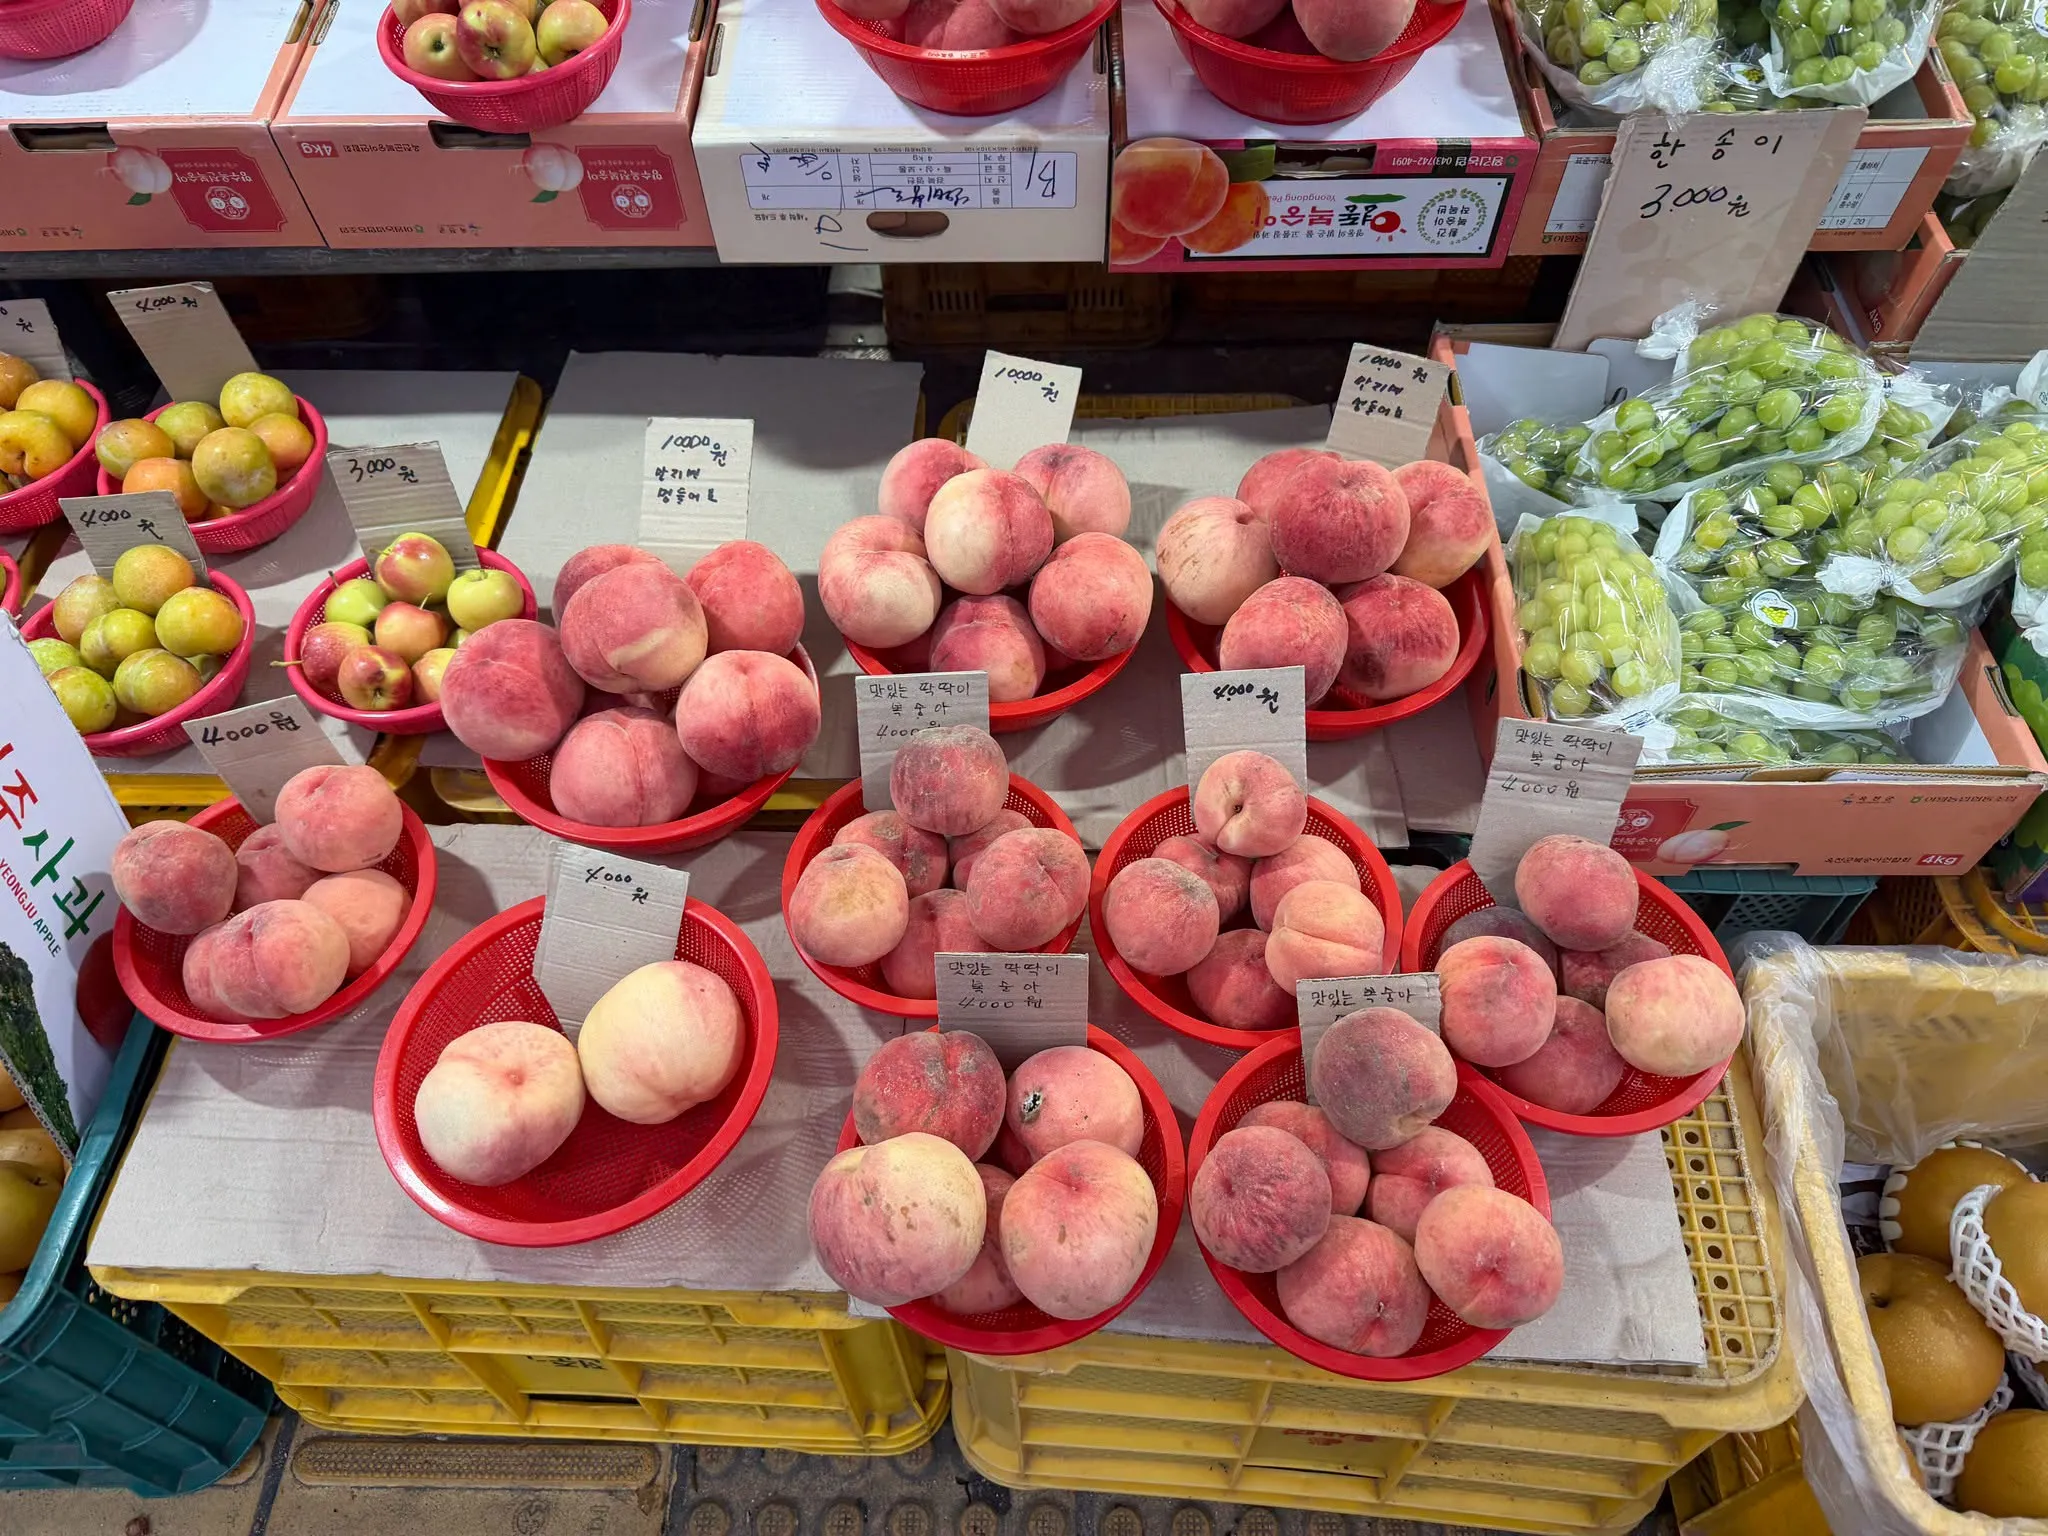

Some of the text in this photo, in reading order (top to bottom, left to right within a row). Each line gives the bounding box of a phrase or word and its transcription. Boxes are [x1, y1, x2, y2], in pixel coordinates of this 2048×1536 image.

[301, 142, 333, 157] 4kg
[1391, 155, 1504, 167] 황간농협 043)742-4091
[1285, 193, 1336, 203] Yeongdong
[1434, 216, 1468, 227] 복숭아
[1437, 227, 1459, 238] 황간
[868, 682, 909, 699] 맛있는
[1514, 727, 1554, 748] 맛있는
[1920, 854, 1958, 866] 4kg
[0, 857, 62, 959] YEONGJU APPLE
[948, 961, 994, 977] 맛있는
[1311, 988, 1356, 1008] 맛있는
